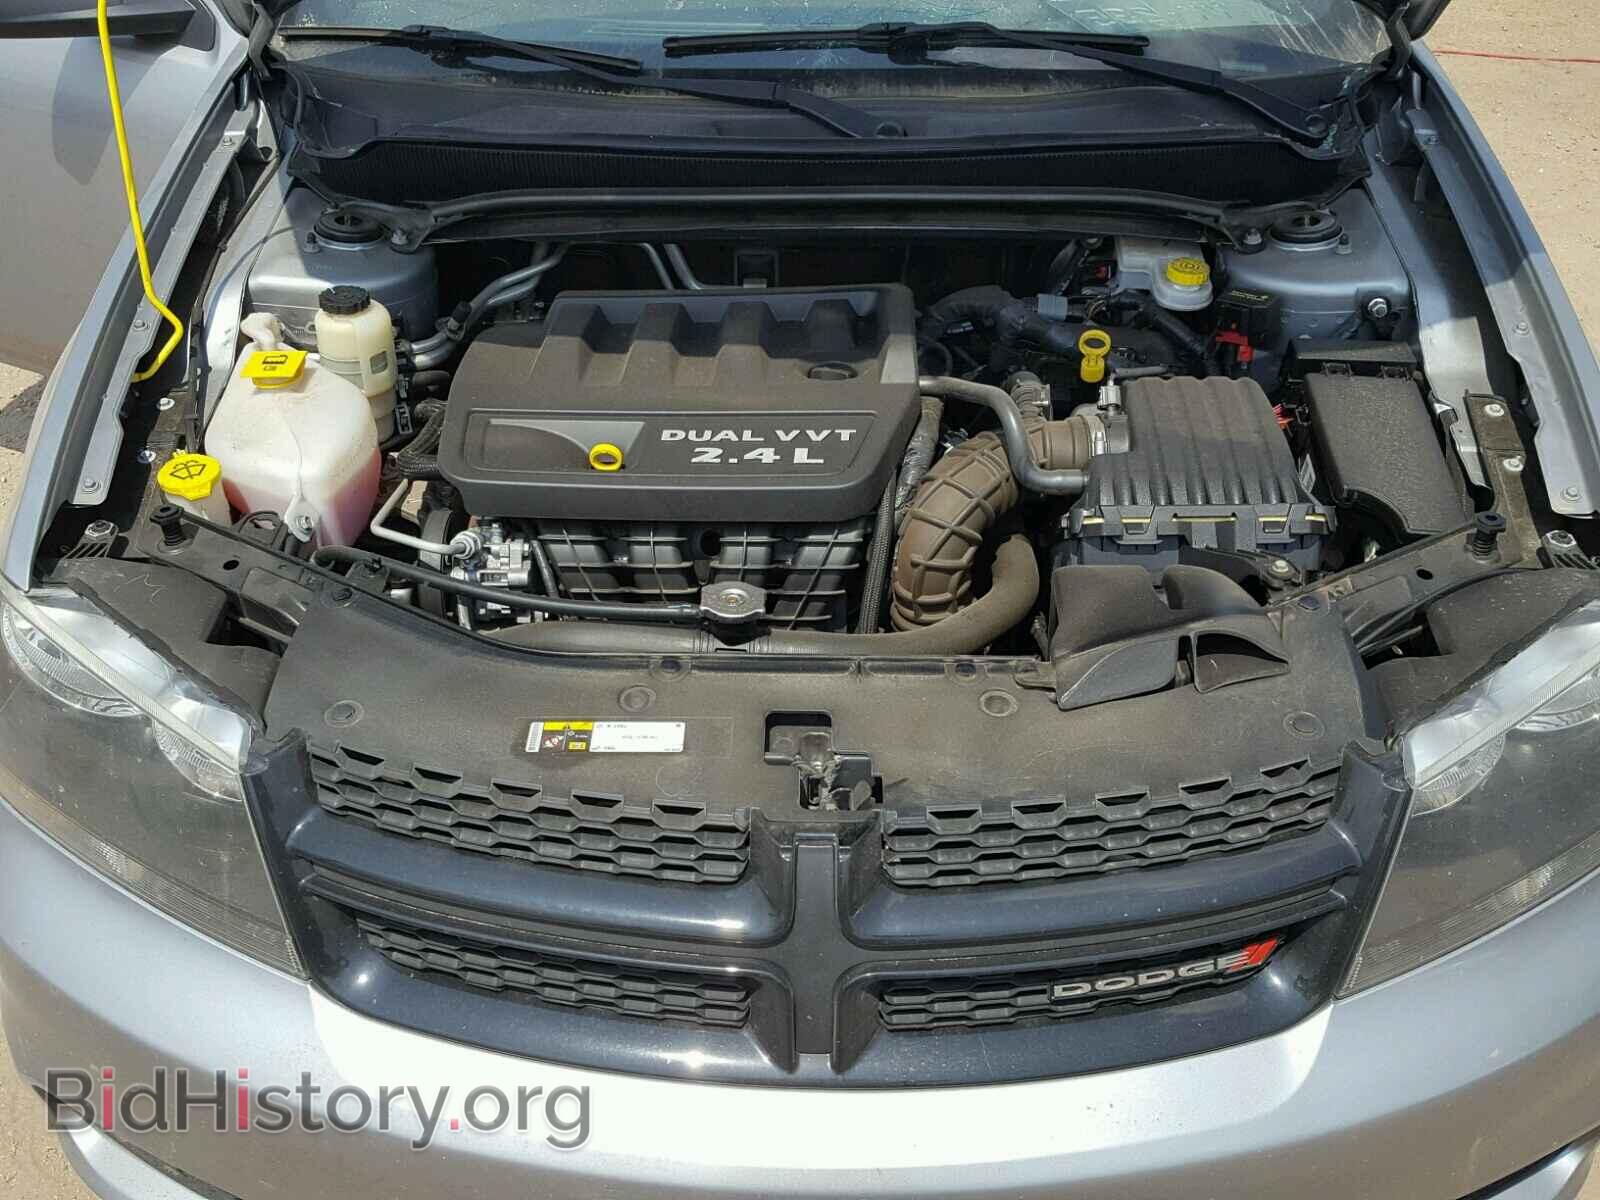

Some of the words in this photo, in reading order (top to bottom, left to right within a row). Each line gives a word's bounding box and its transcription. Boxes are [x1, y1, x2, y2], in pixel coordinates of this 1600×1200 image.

[660, 429, 765, 441] DUAL
[775, 429, 857, 441] VVT
[1053, 949, 1250, 998] DODGE
